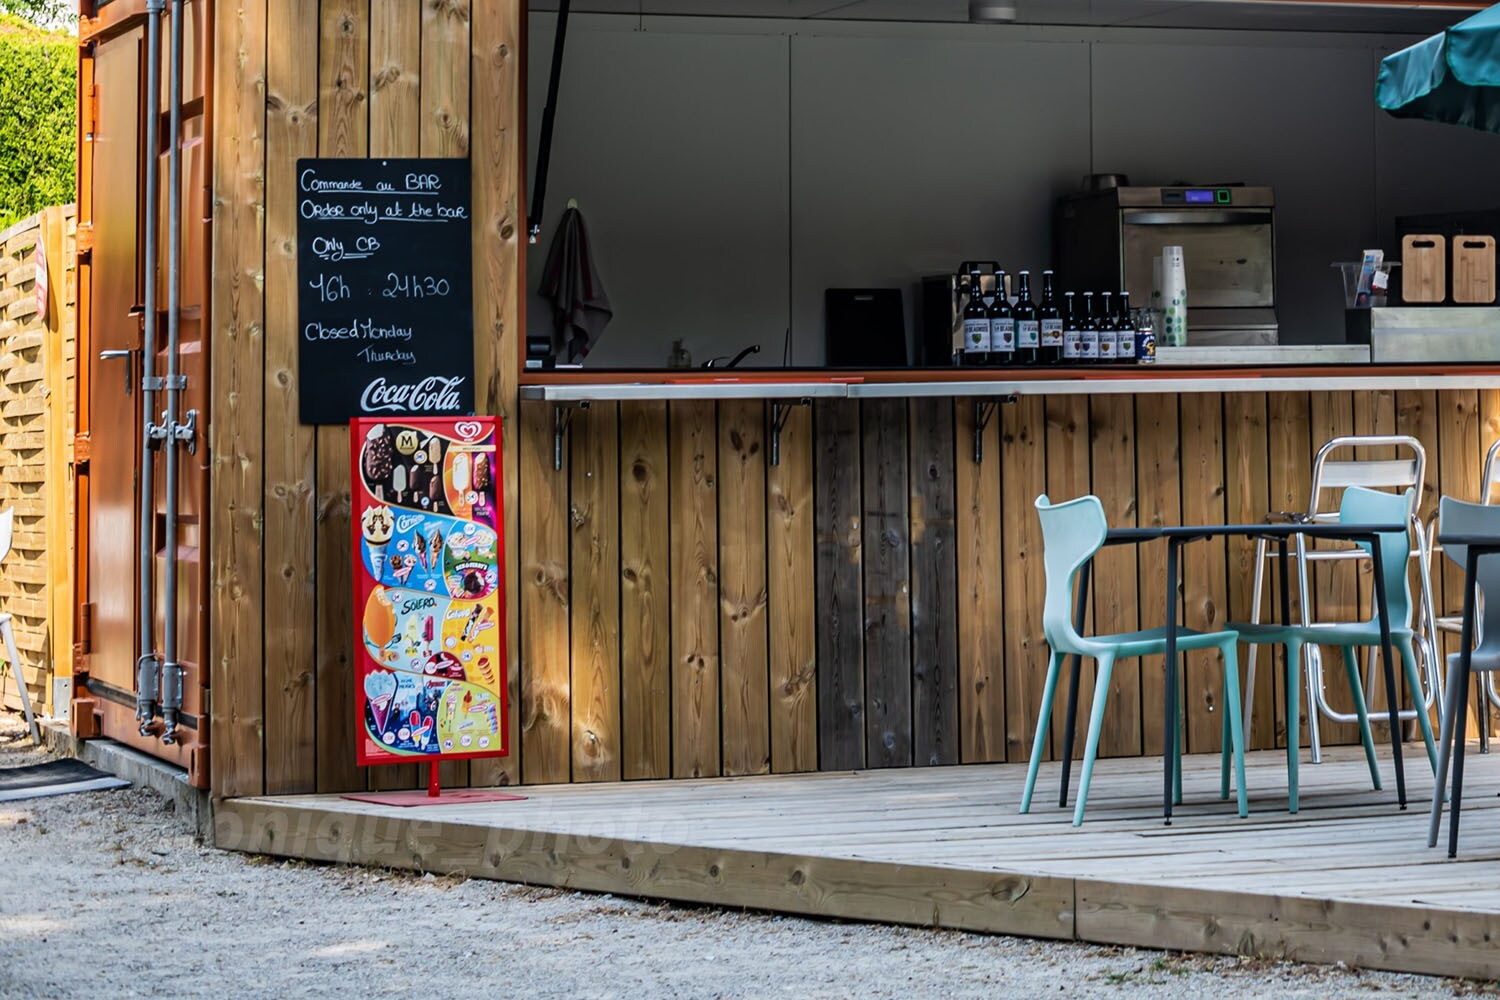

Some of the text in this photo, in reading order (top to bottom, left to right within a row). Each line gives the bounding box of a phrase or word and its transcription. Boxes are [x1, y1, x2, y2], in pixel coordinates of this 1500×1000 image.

[301, 169, 441, 191] Commande au BAR
[350, 201, 378, 224] only
[385, 201, 402, 216] at
[408, 202, 433, 217] the
[312, 237, 380, 260] Only CB
[305, 318, 413, 341] Closed Monday
[360, 376, 466, 412] Coca-Cola
